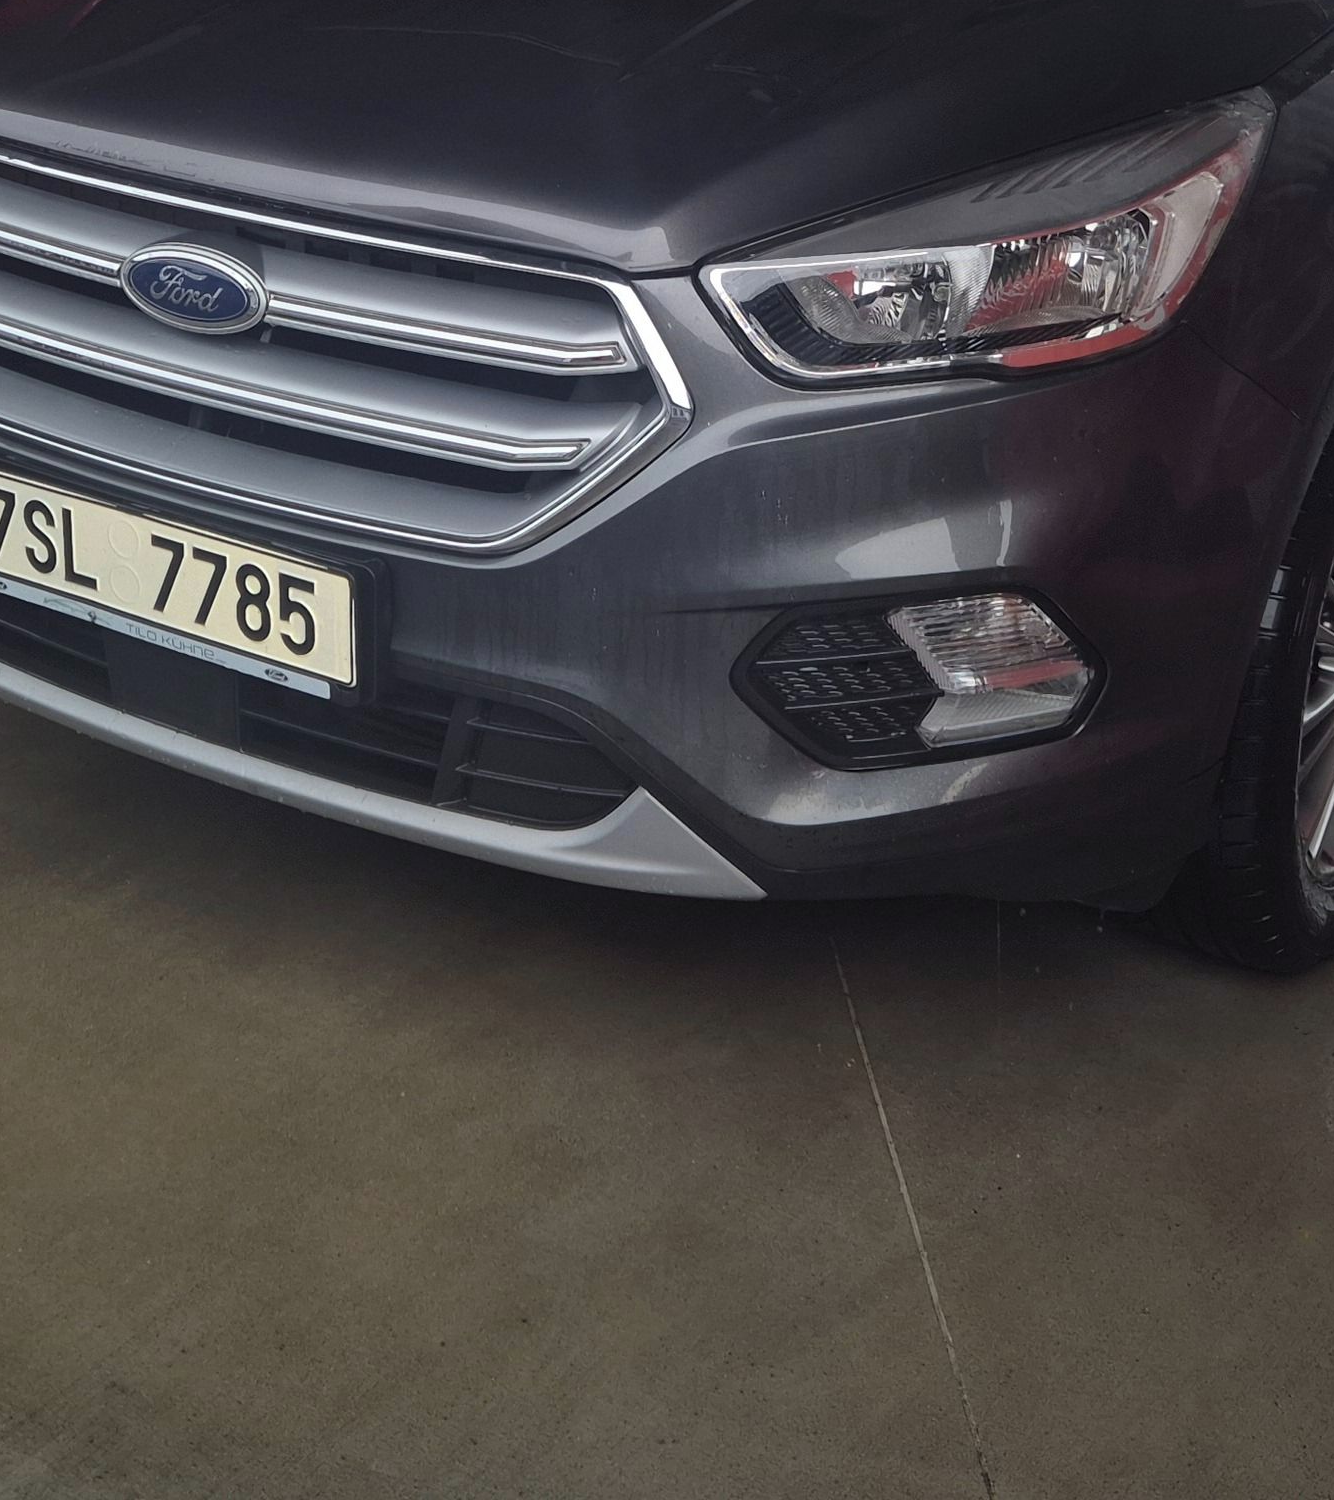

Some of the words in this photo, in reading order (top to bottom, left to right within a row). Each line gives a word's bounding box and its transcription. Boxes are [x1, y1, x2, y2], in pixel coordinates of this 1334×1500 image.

[149, 265, 223, 313] Ford
[150, 534, 316, 656] 7785
[126, 622, 157, 642] TILO
